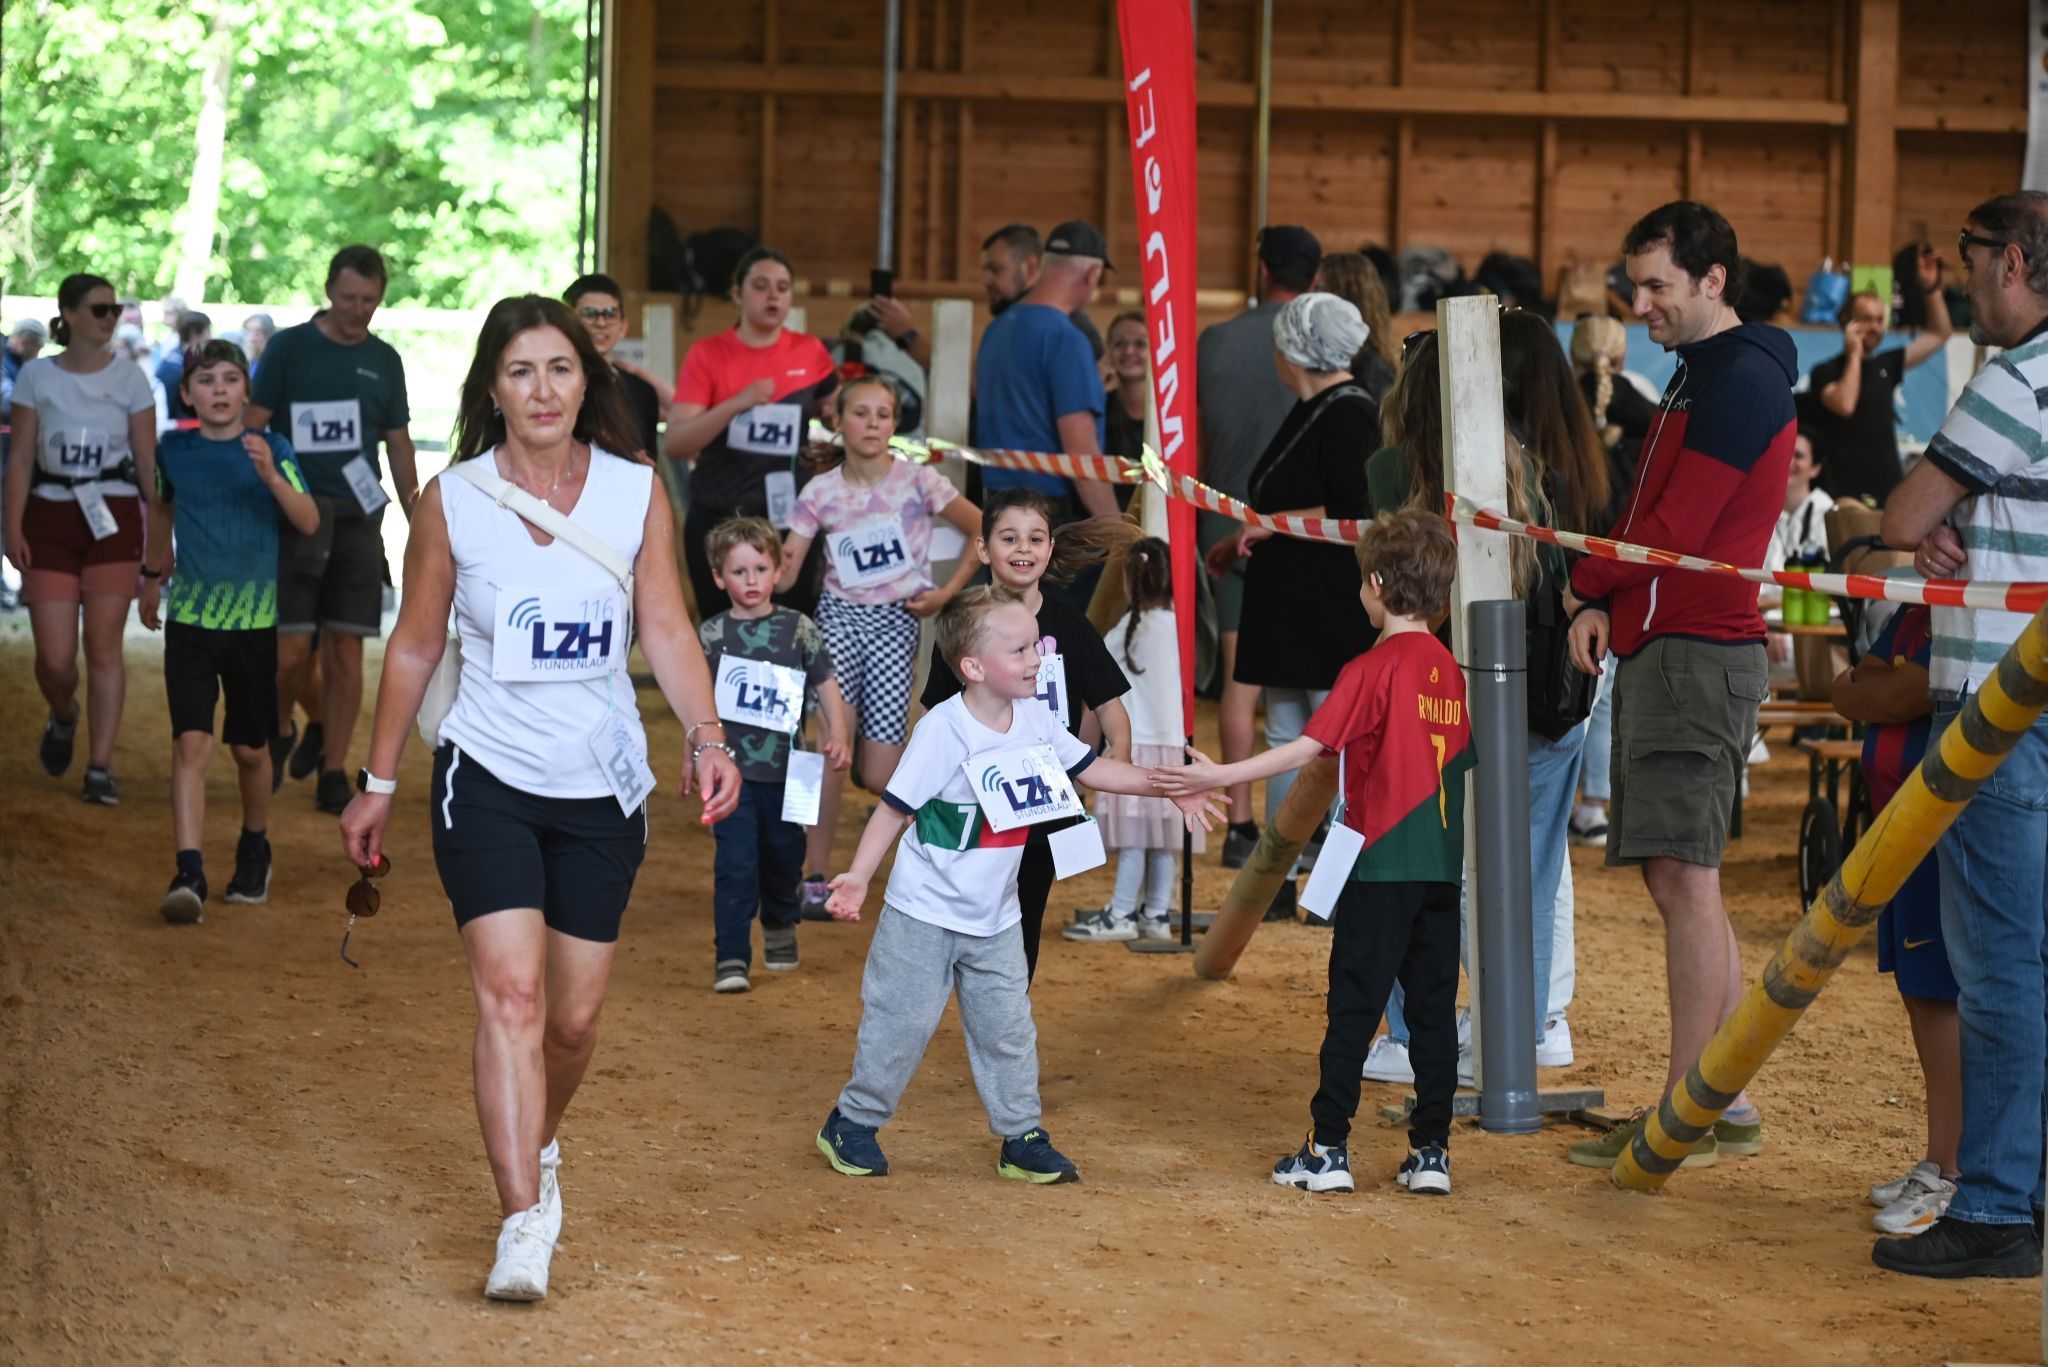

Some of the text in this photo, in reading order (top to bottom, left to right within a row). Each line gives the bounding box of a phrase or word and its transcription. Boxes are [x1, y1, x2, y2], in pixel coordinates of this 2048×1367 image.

[312, 419, 354, 443] LZH
[749, 423, 792, 445] LZH
[61, 445, 102, 466] LZH
[853, 538, 904, 572] LZH
[580, 597, 613, 622] 116
[532, 620, 612, 659] LZH
[531, 659, 608, 671] STUNDENLAUF
[1418, 693, 1461, 726] RNALDO
[608, 747, 643, 805] LZH
[1430, 733, 1447, 829] 7
[1015, 801, 1072, 820] STUNDENLAUF
[957, 804, 977, 851] 7
[1024, 1131, 1040, 1142] FILA
